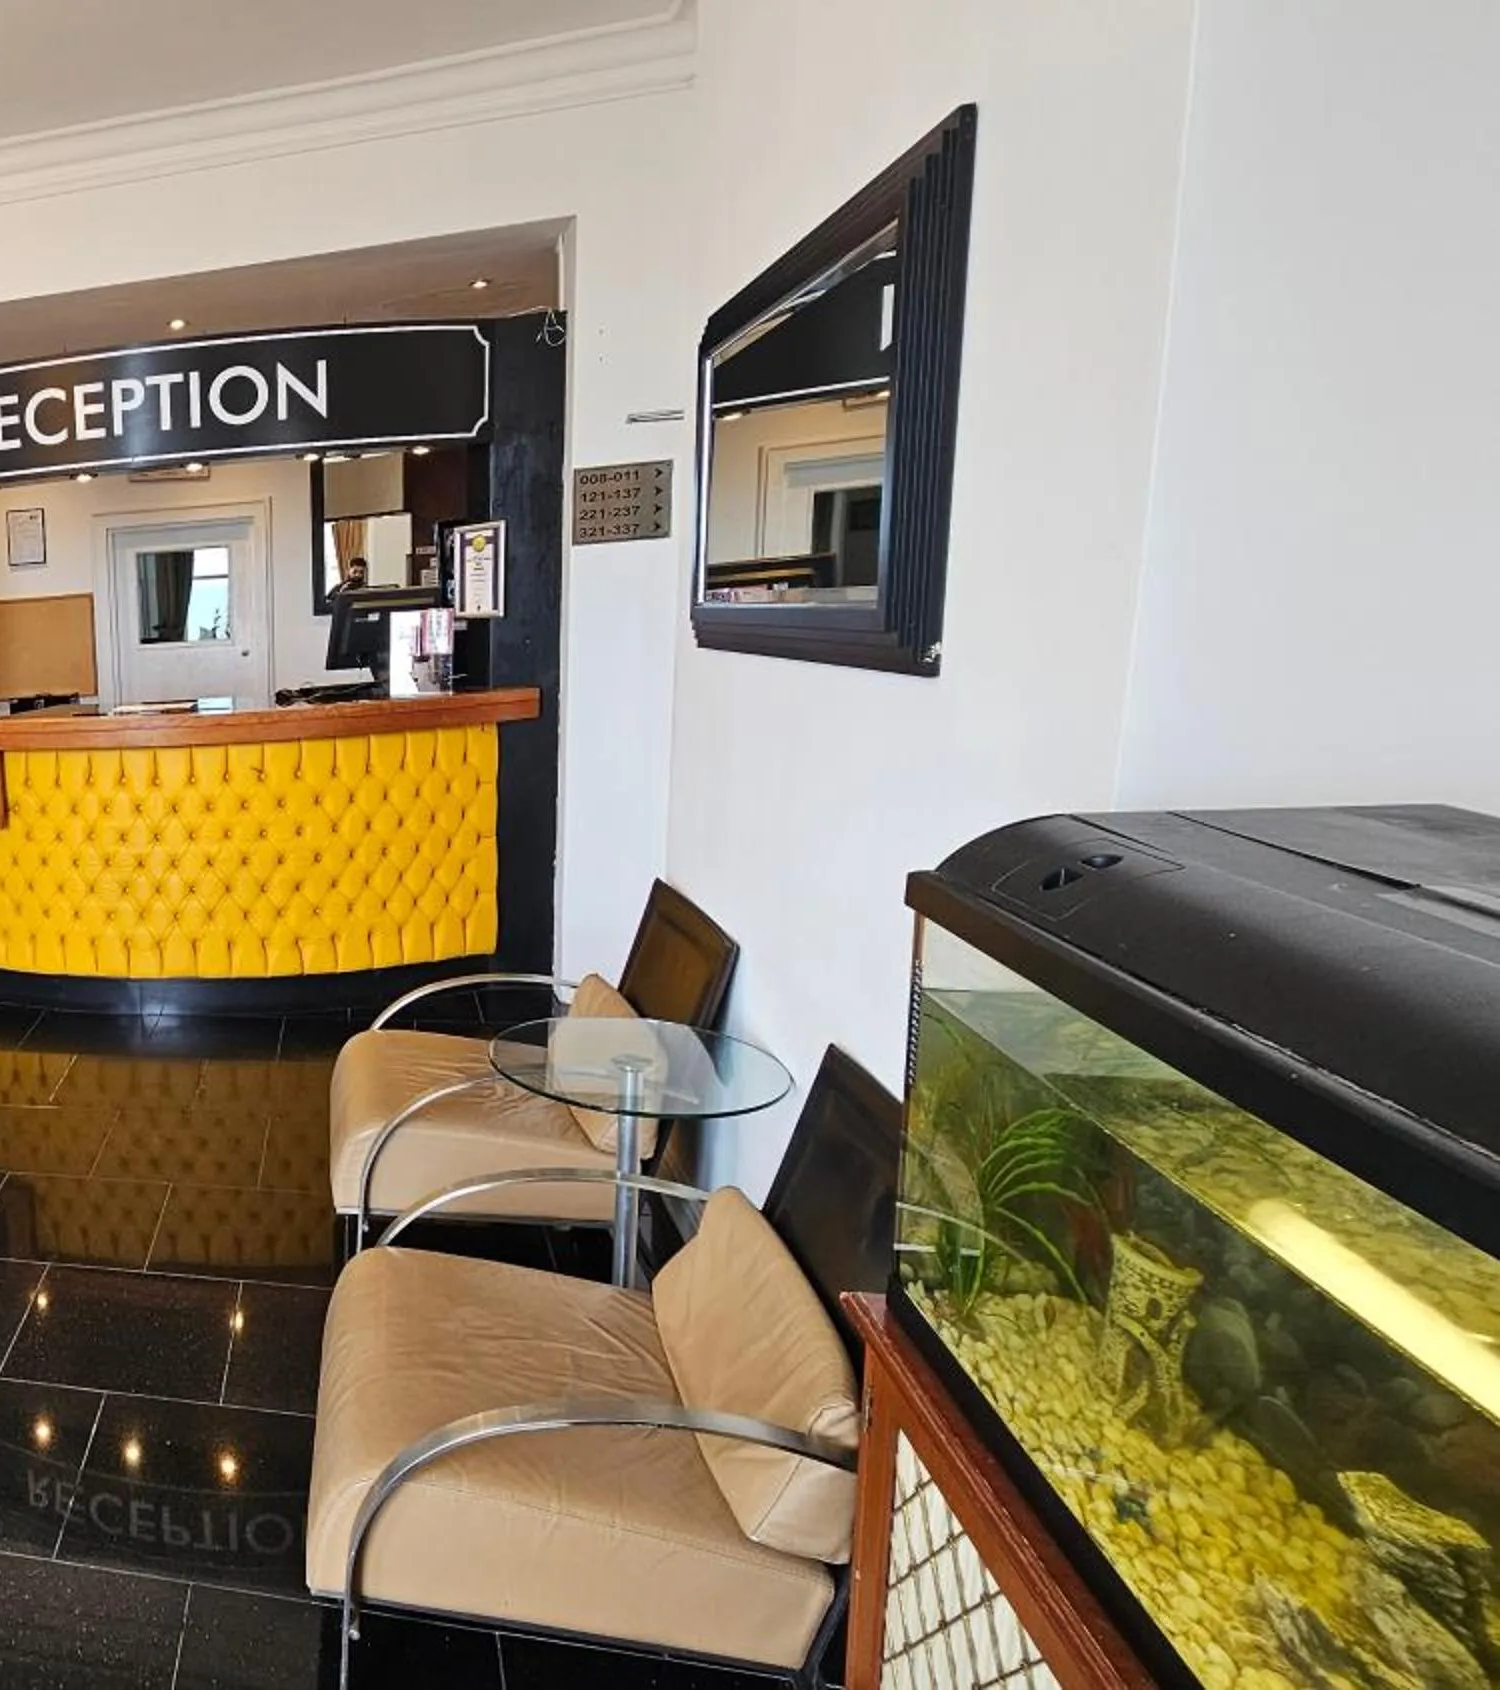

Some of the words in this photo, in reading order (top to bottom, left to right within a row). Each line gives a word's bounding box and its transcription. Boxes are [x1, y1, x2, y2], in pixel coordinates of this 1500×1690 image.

[581, 487, 640, 502] 121-137
[580, 505, 640, 520] 221-237
[580, 523, 640, 538] 321-337
